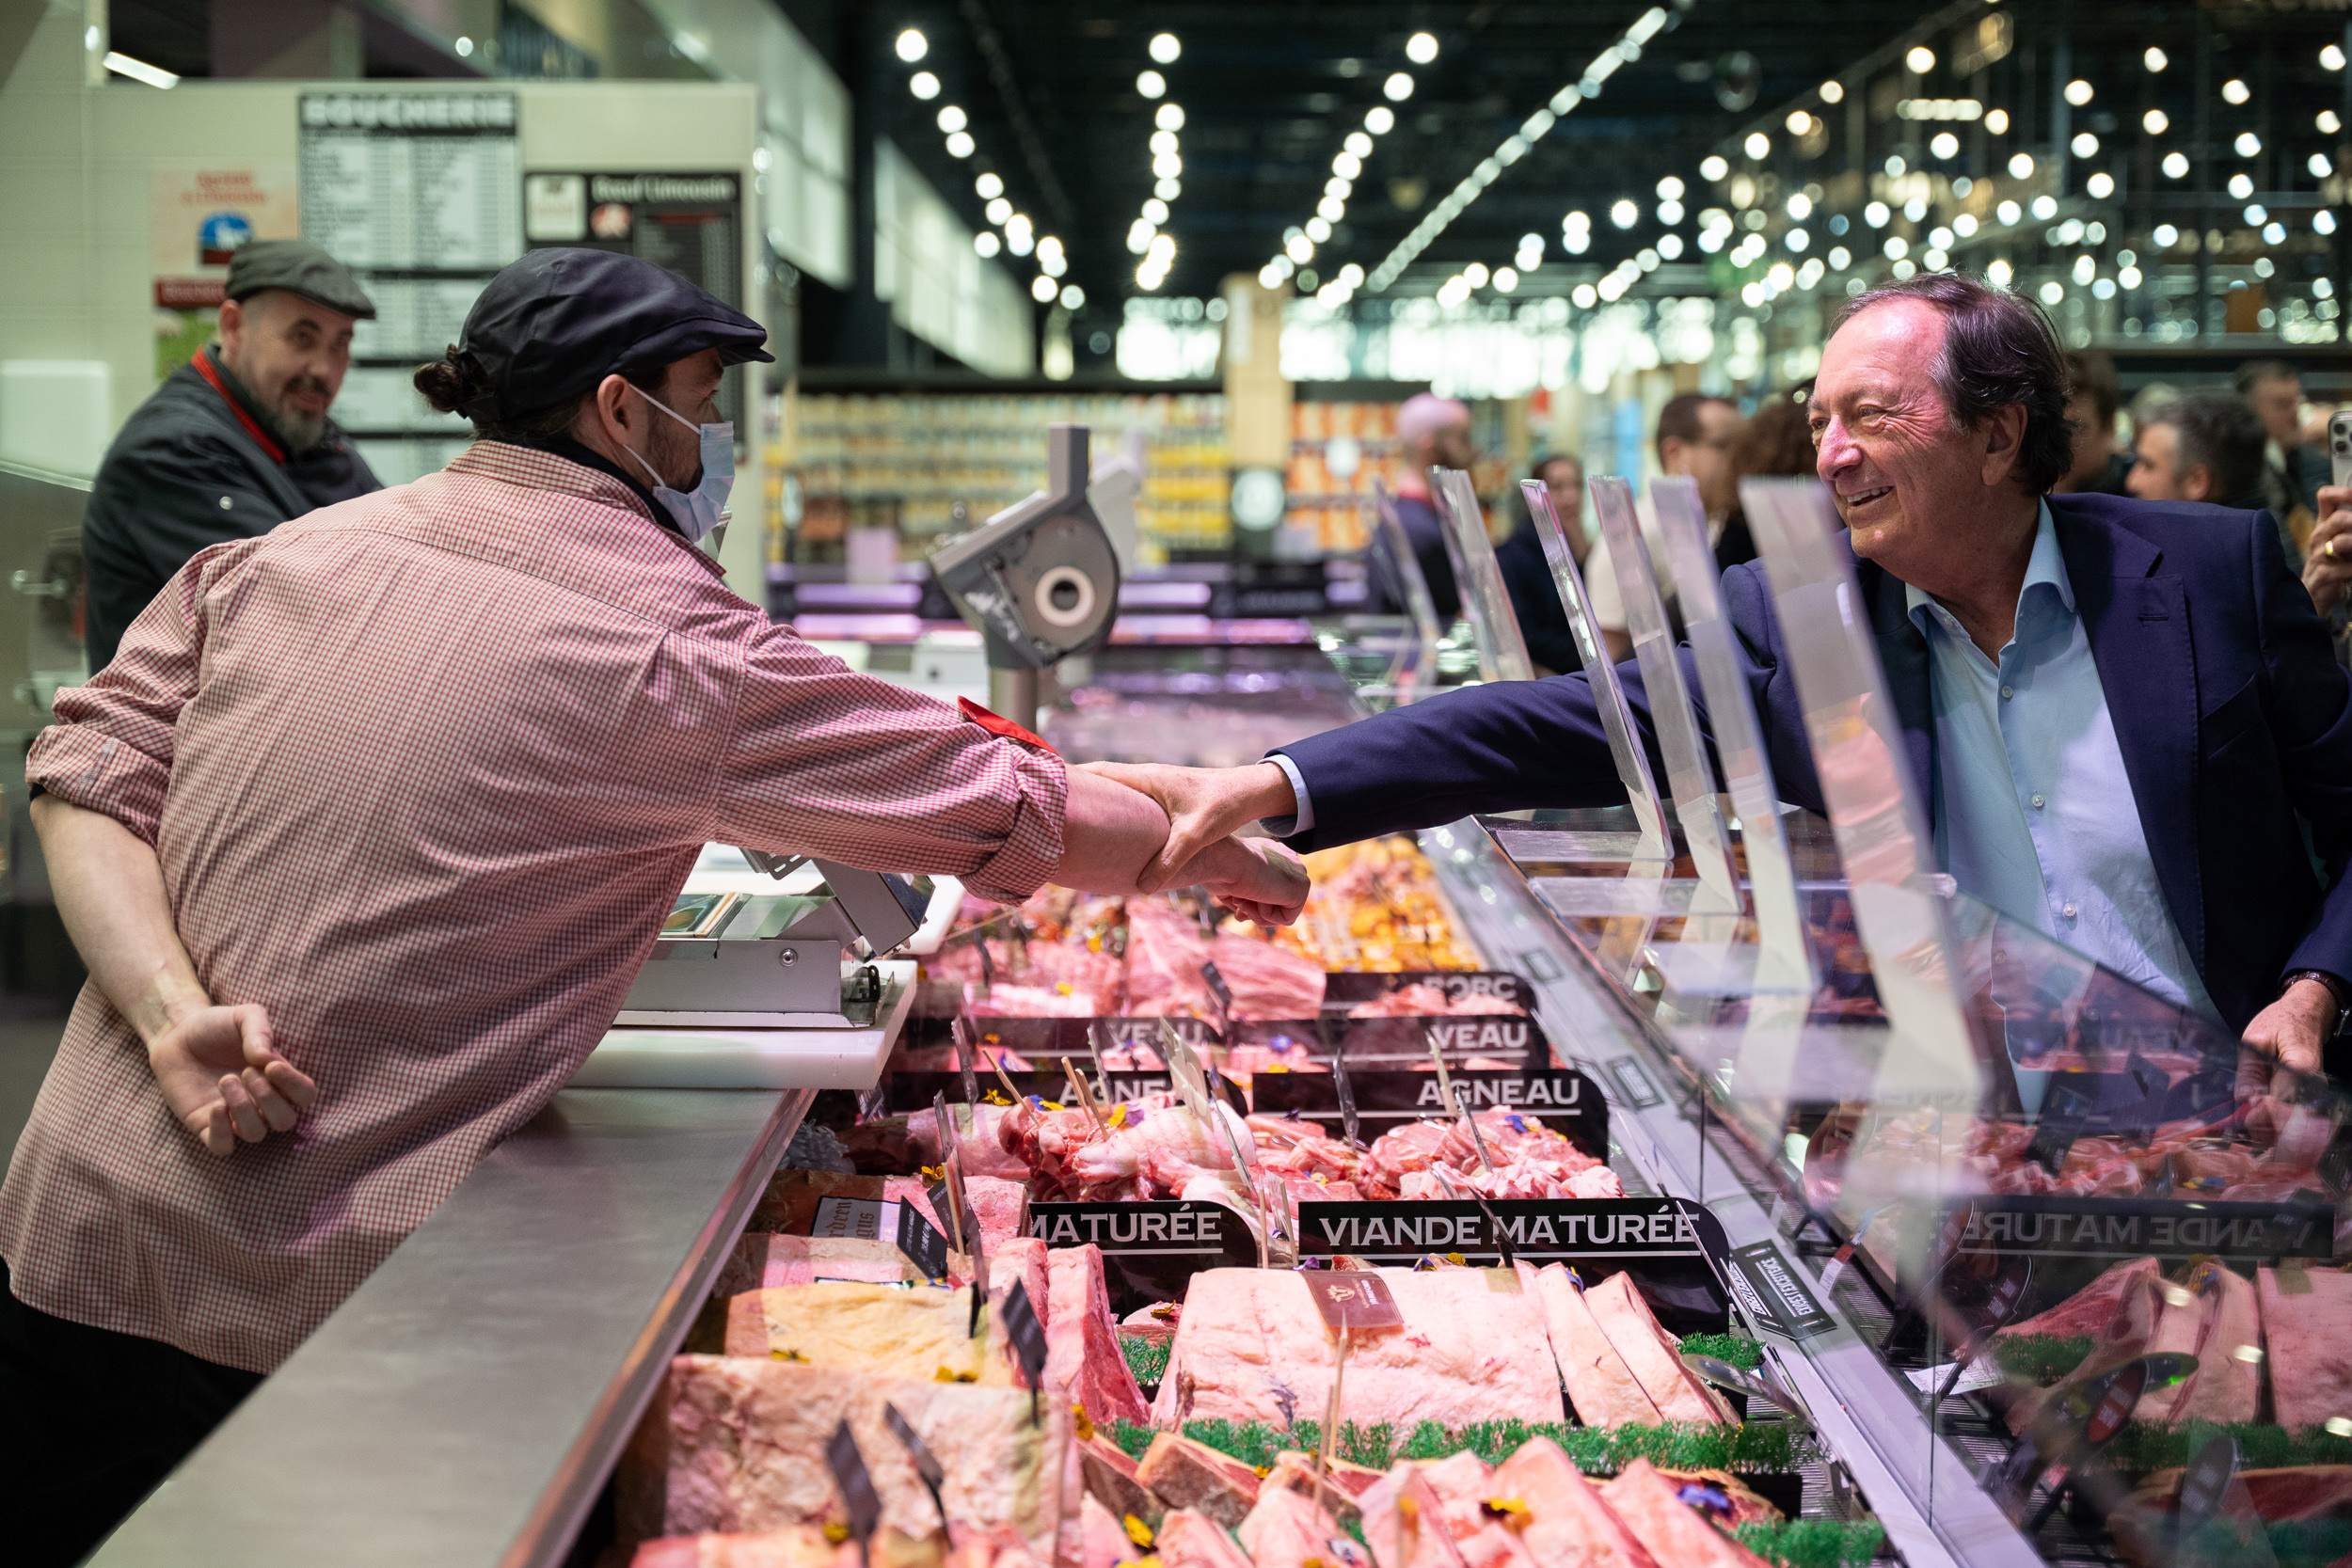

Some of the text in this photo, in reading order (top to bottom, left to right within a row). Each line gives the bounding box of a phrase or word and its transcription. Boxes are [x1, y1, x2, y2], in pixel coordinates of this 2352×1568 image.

[303, 96, 513, 128] BOUCHERIE
[1106, 1022, 1203, 1043] VEU
[1430, 1023, 1527, 1049] VEAU
[1058, 1078, 1184, 1105] AGNE
[1417, 1078, 1580, 1105] AGNEAU
[1030, 1203, 1221, 1242] MATURÉE
[1319, 1204, 1700, 1246] VIANDE MATURÉE
